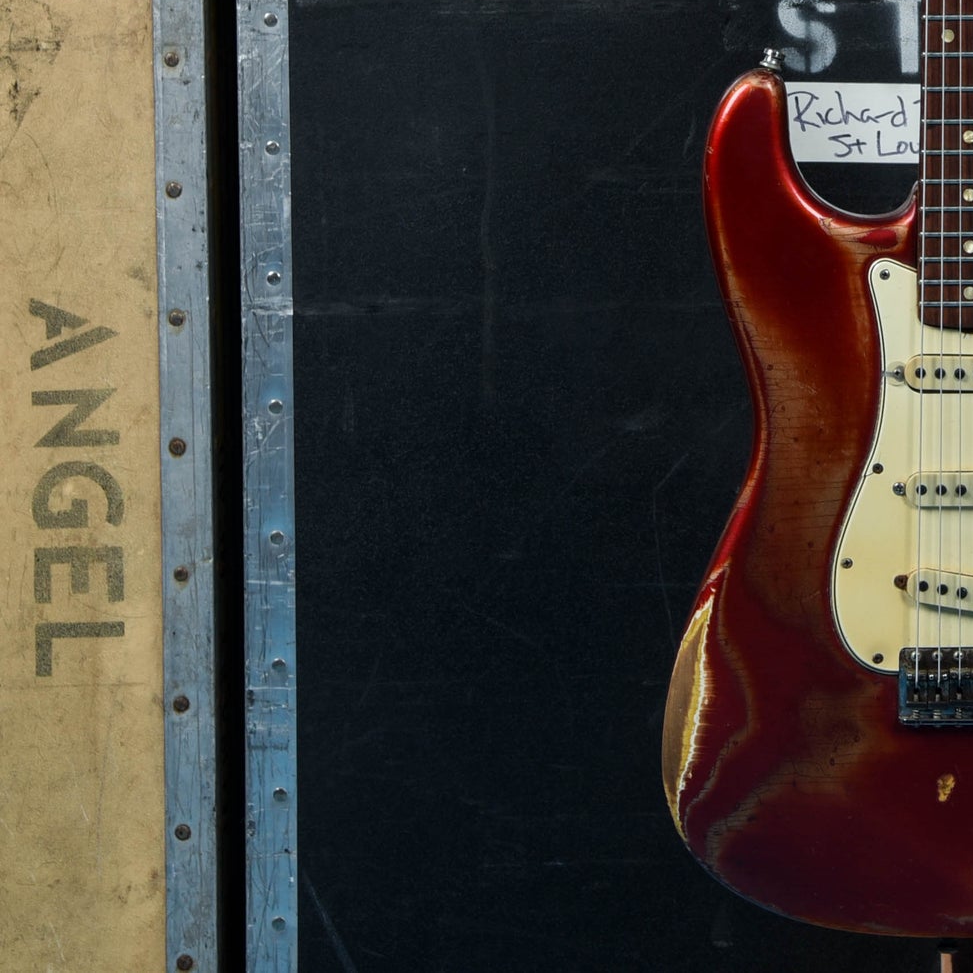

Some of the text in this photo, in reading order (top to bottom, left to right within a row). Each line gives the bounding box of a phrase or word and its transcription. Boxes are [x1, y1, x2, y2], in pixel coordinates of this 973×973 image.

[789, 90, 908, 132] Richard
[829, 134, 867, 158] St
[29, 298, 125, 677] ANGEL
